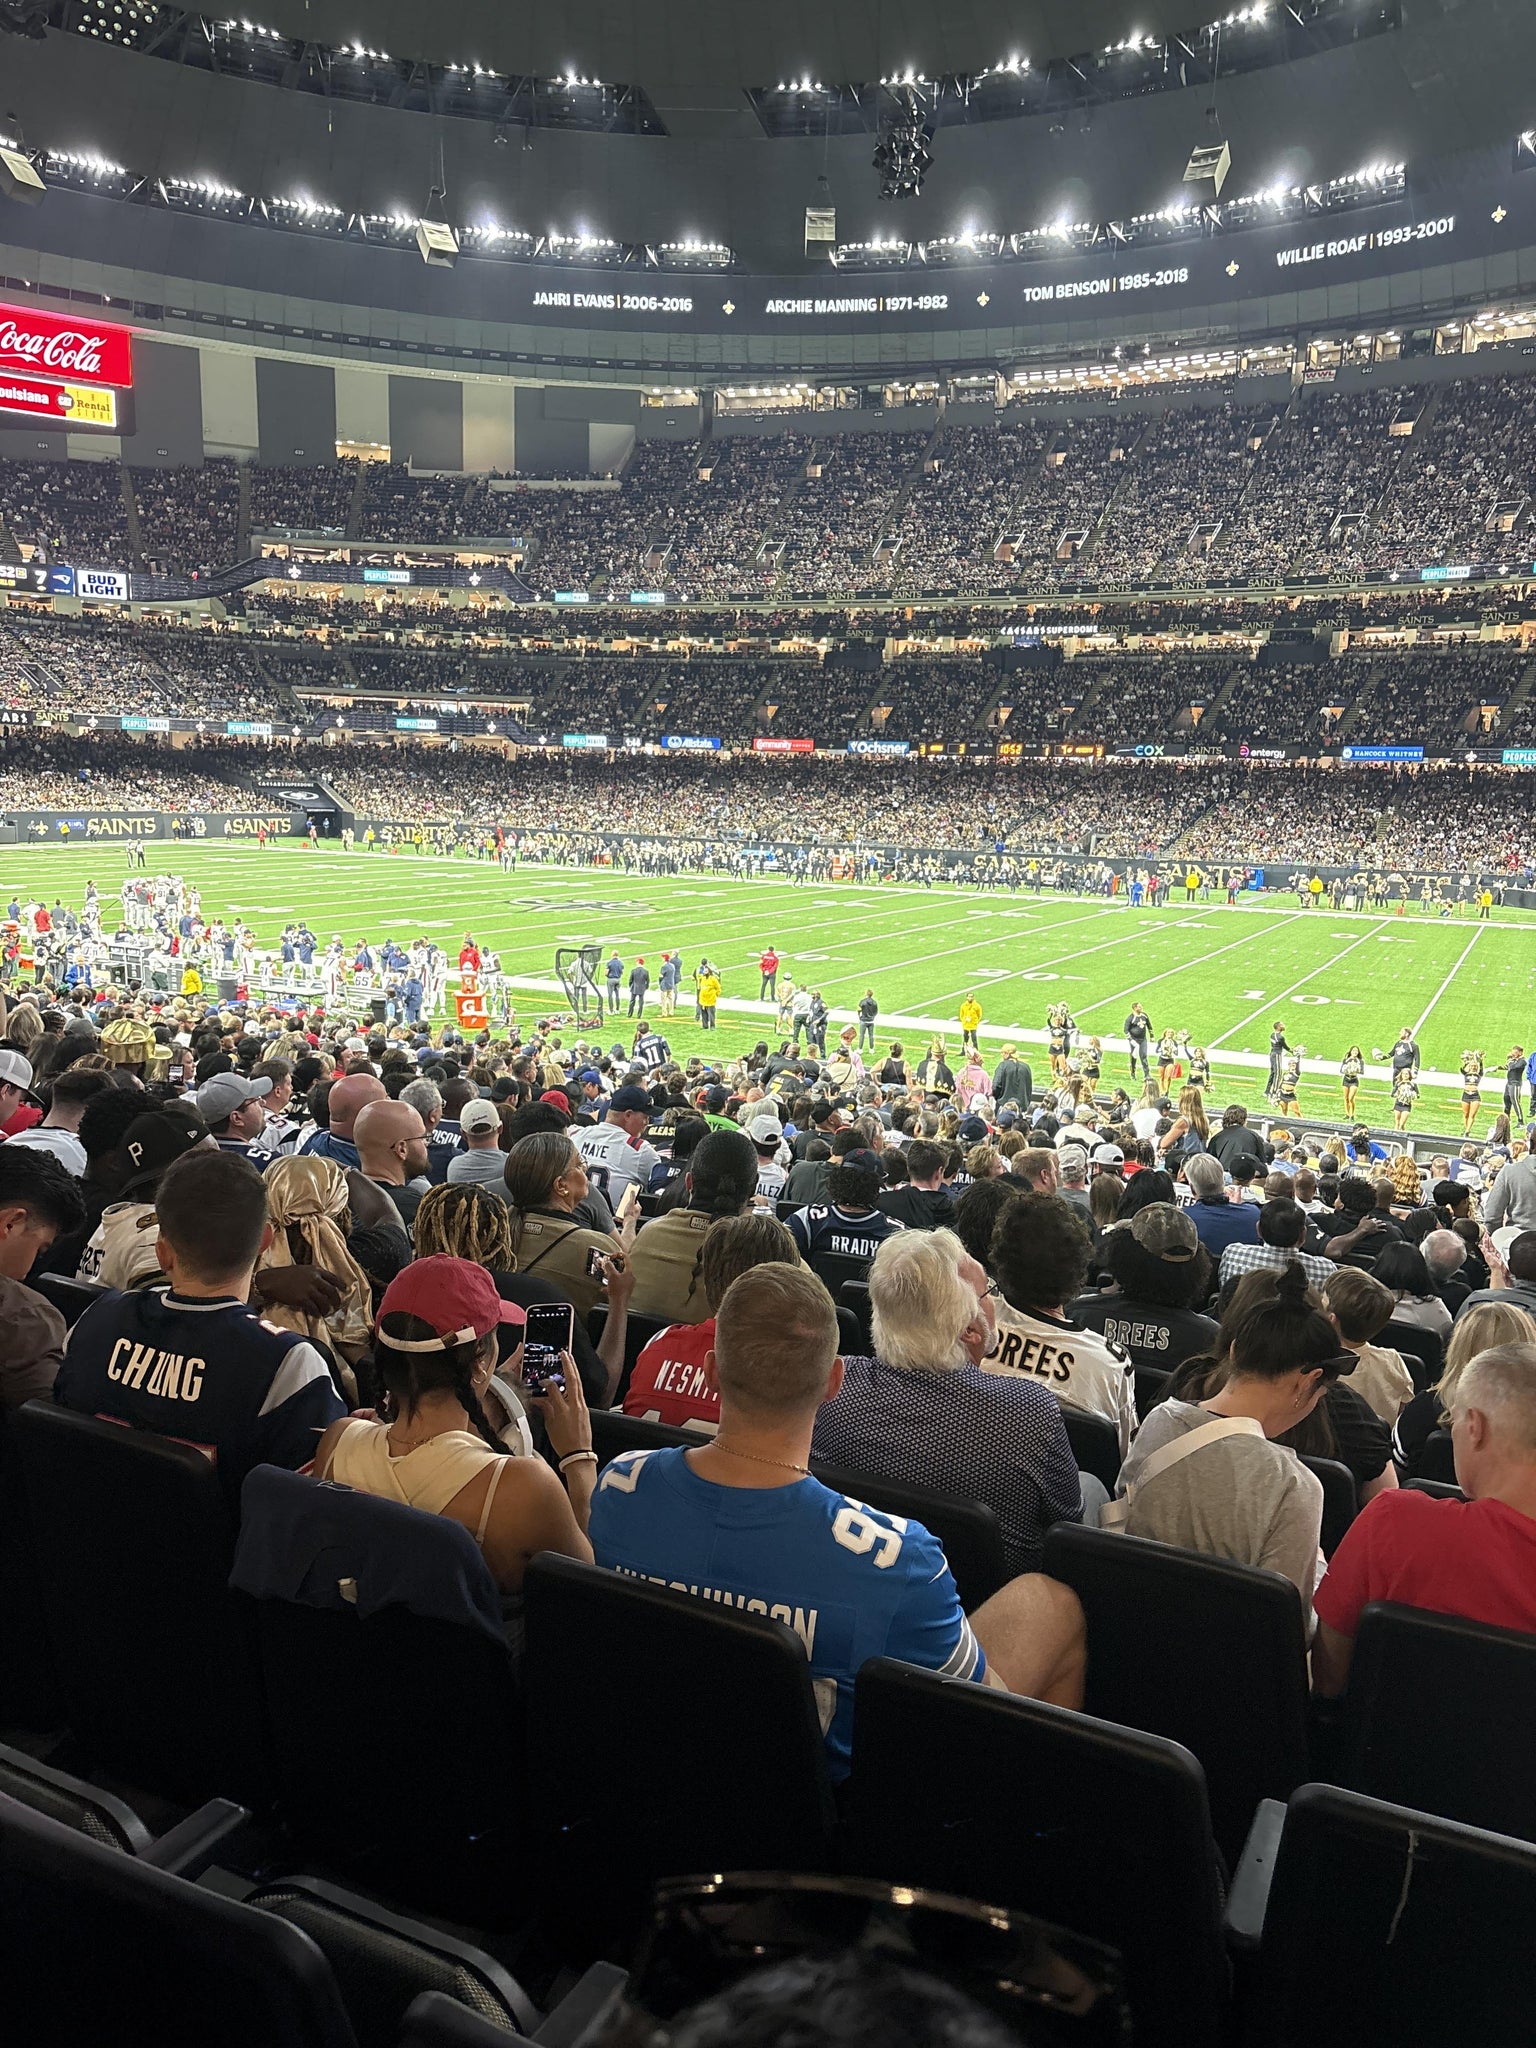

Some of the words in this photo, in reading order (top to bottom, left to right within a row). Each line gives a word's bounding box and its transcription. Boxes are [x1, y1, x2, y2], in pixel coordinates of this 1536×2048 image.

[1276, 243, 1325, 267] WILLIE
[1327, 235, 1368, 257] ROAF
[1376, 216, 1455, 247] 1993-2001
[1023, 286, 1053, 301] TOM
[1055, 279, 1110, 299] BENSON
[1119, 268, 1188, 291] 1985-2018
[532, 292, 571, 306] JAHRI
[573, 293, 615, 309] EVANS
[622, 295, 693, 311] 2006-2016
[765, 299, 813, 313] ARCHIE
[815, 298, 877, 313] MANNING
[885, 295, 948, 311] 1971-1982
[0, 387, 50, 405] ouisiana
[77, 400, 110, 412] Rental
[34, 570, 48, 585] 7
[87, 574, 117, 585] BUD
[1328, 574, 1366, 584] SAINTS
[1098, 583, 1132, 593] SAINTS
[1172, 580, 1207, 591] SAINTS
[1247, 578, 1284, 588] SAINTS
[82, 584, 123, 596] LIGHT
[891, 590, 922, 600] SAINTS
[957, 588, 989, 598] SAINTS
[1026, 586, 1060, 595] SAINTS
[700, 594, 729, 602] SAINTS
[763, 593, 793, 601] SAINTS
[826, 591, 857, 600] SAINTS
[290, 614, 319, 623] SAINTS
[1398, 615, 1434, 625] SAINTS
[1481, 611, 1520, 621] SAINTS
[353, 618, 381, 627] SAINTS
[1168, 623, 1200, 632] SAINTS
[1241, 621, 1275, 630] SAINTS
[1316, 618, 1350, 628] SAINTS
[542, 628, 569, 636] SAINTS
[601, 629, 629, 637] SAINTS
[663, 629, 690, 637] SAINTS
[722, 629, 749, 637] SAINTS
[784, 629, 812, 638] SAINTS
[846, 629, 874, 637] SAINTS
[907, 628, 936, 637] SAINTS
[971, 627, 1000, 636] SAINTS
[1000, 625, 1045, 635] CAESARS
[1046, 625, 1098, 634] SUPERDOME
[1100, 624, 1130, 633] SAINTS
[0, 711, 28, 724] ARS
[35, 711, 69, 722] SAINTS
[723, 739, 751, 748] SAINTS
[857, 741, 908, 755] Ochsner
[1000, 744, 1022, 755] 10:52
[1134, 744, 1165, 756] COX
[1188, 746, 1223, 755] SAINTS
[1250, 749, 1286, 759] entergy
[87, 817, 156, 836] SAINTS
[231, 816, 292, 834] SAINTS
[462, 999, 475, 1015] G
[645, 1049, 661, 1065] 11
[128, 1141, 144, 1167] P
[581, 1141, 610, 1160] MAYE
[831, 1234, 879, 1257] BRADY
[1104, 1318, 1170, 1351] BREES
[107, 1337, 206, 1402] CHUNG
